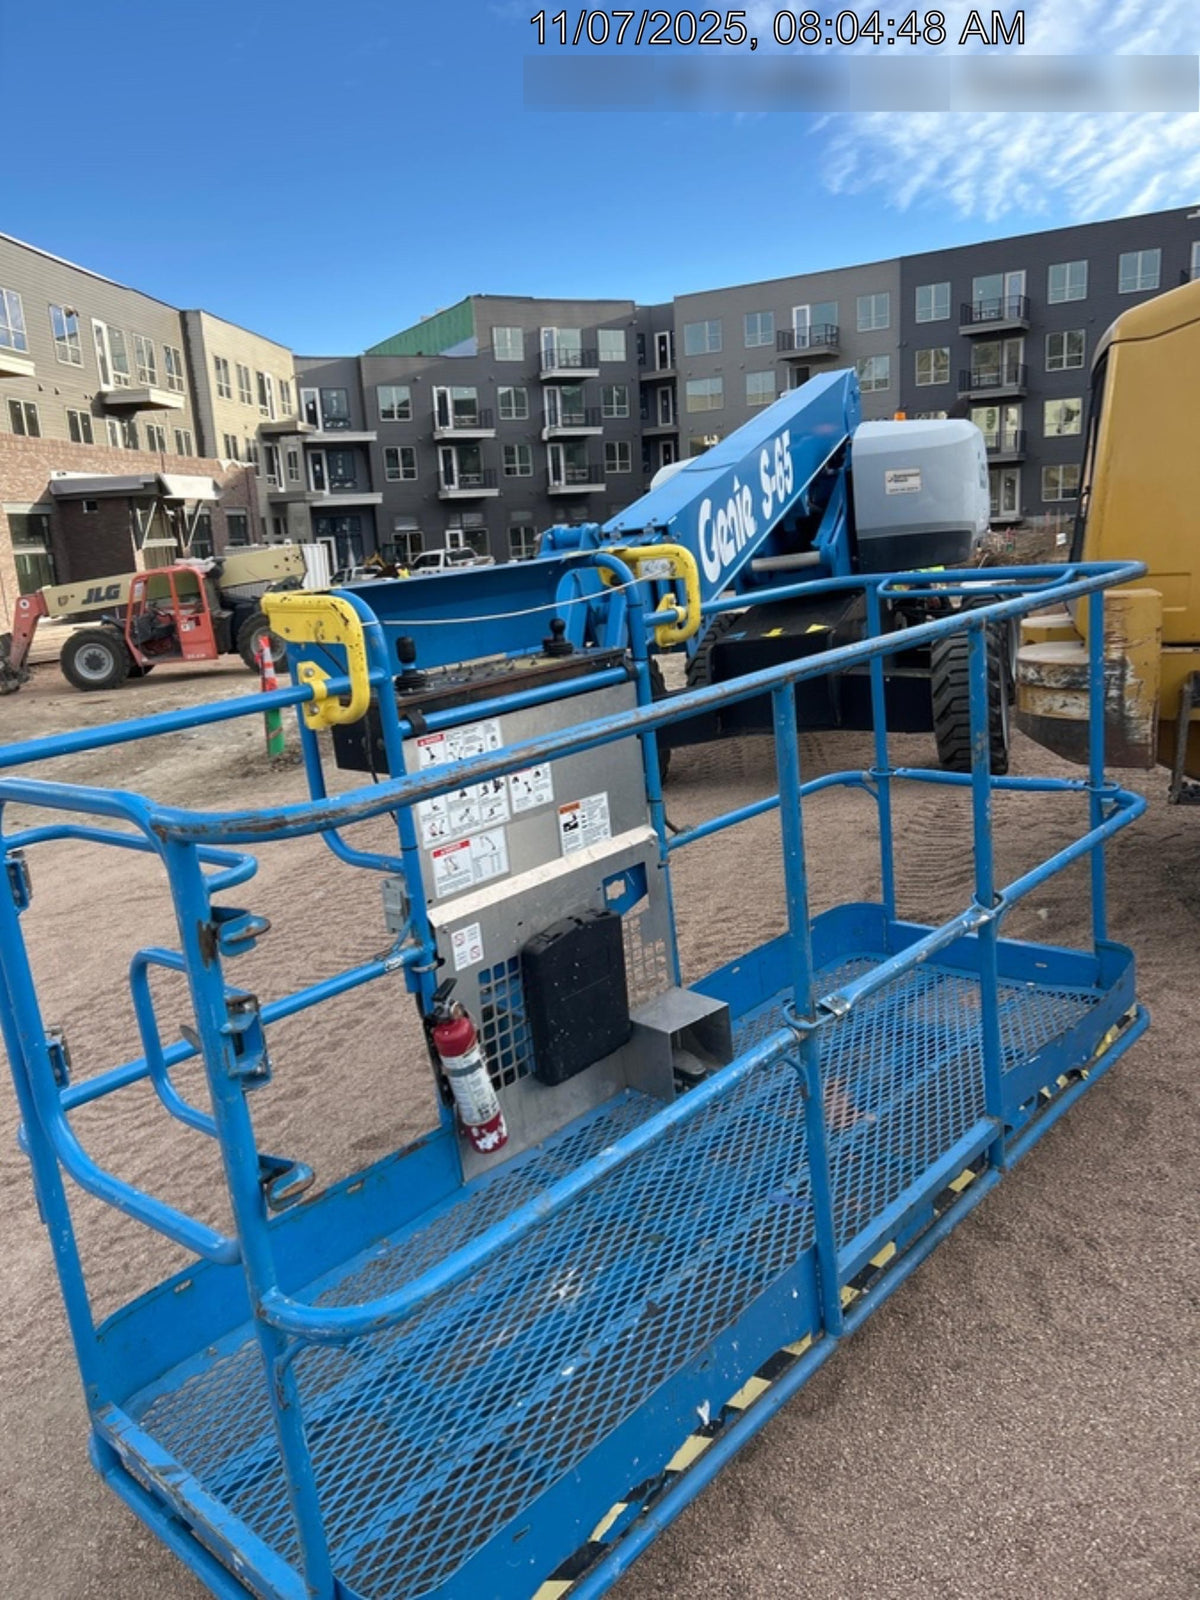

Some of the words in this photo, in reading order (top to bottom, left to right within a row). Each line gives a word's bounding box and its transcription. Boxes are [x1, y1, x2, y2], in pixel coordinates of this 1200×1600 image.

[699, 475, 757, 583] Genie
[760, 430, 793, 519] S-65
[81, 583, 121, 604] JLG
